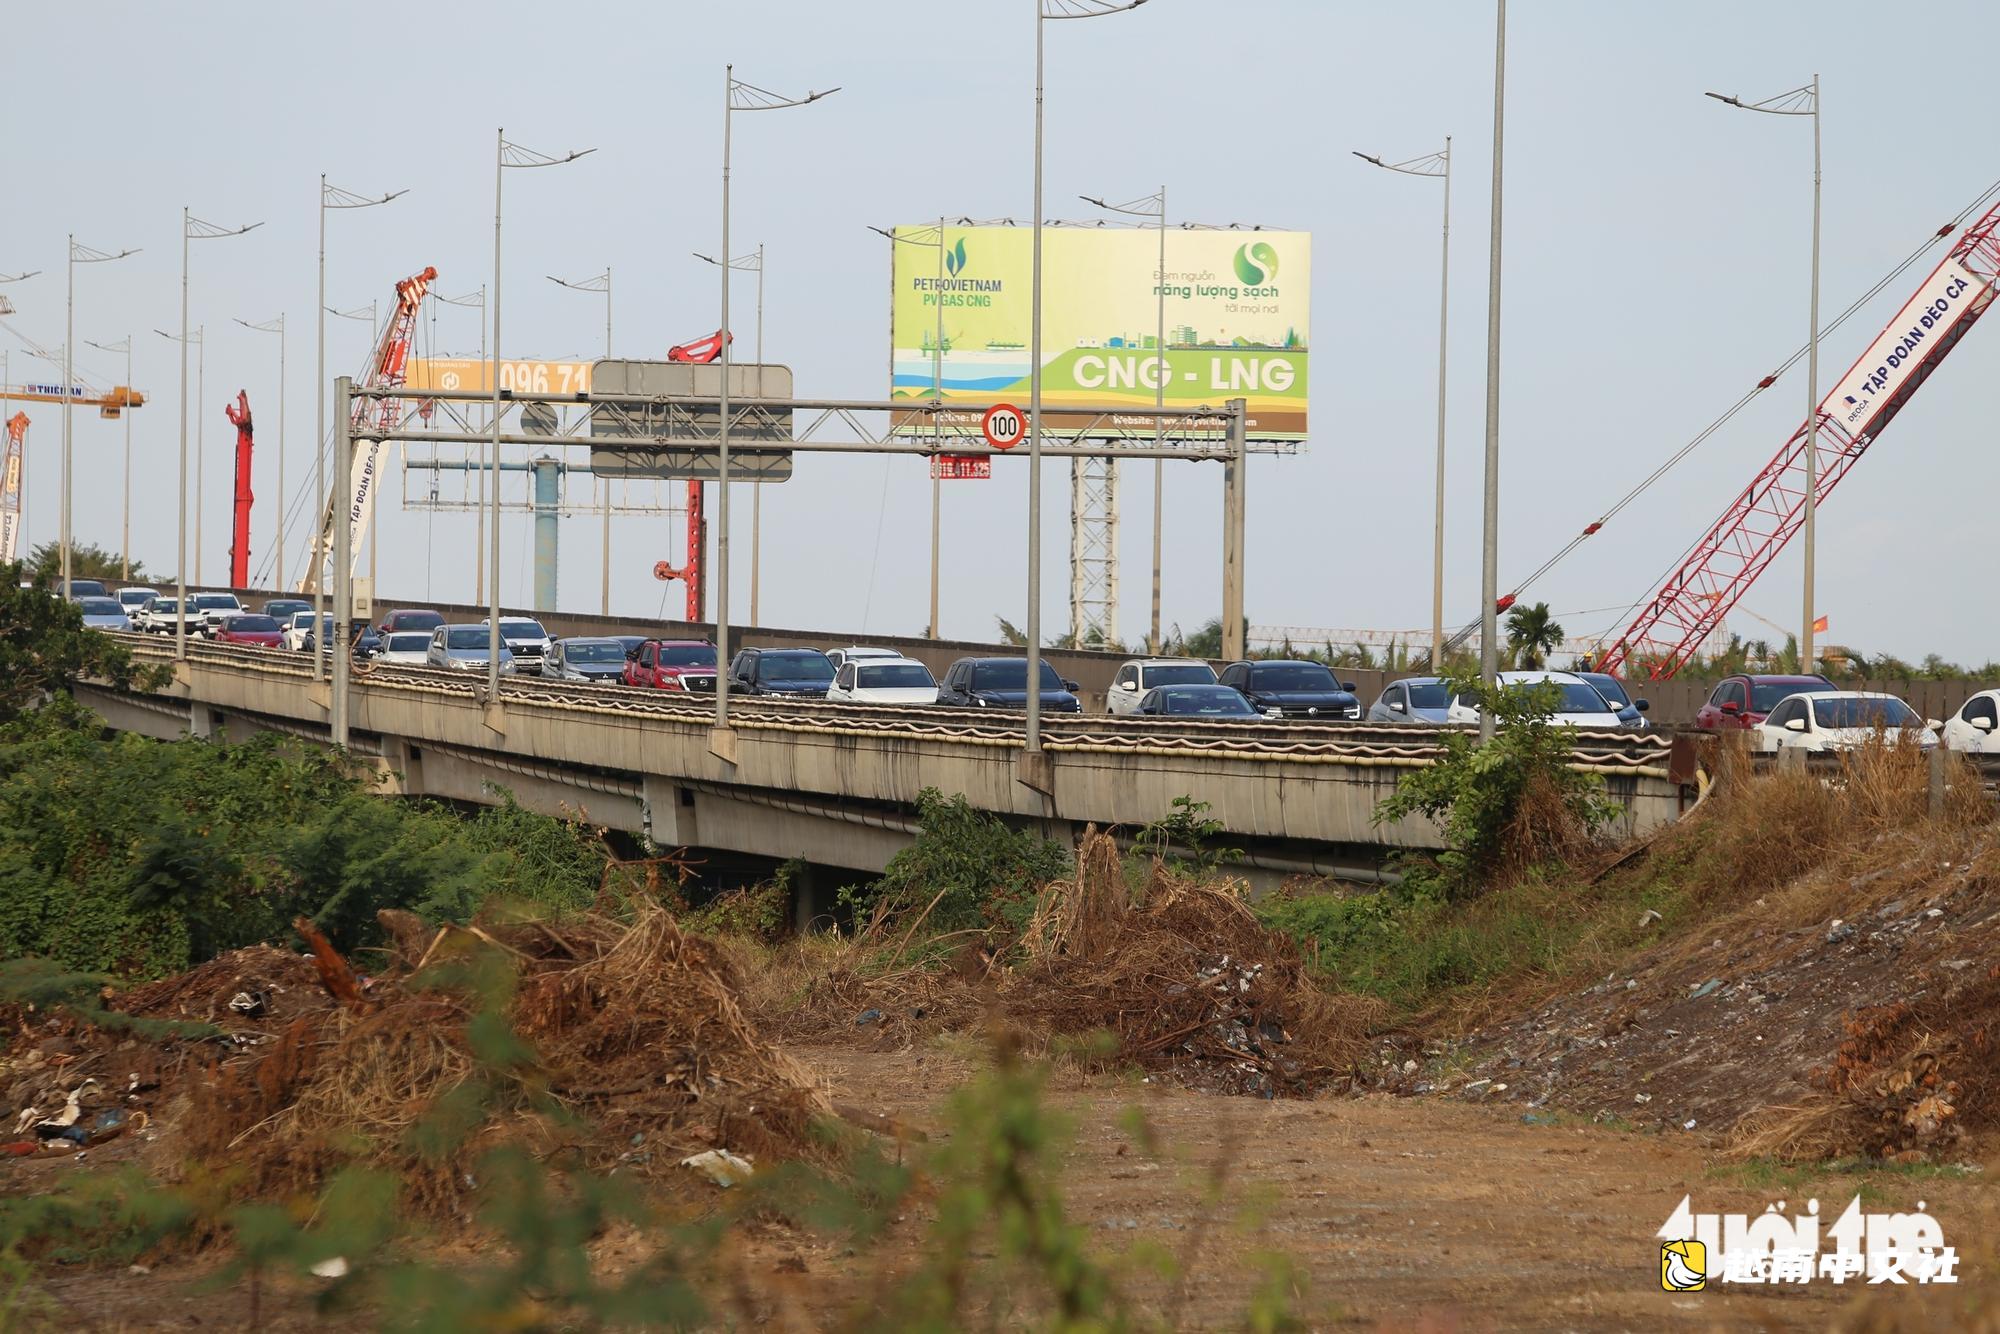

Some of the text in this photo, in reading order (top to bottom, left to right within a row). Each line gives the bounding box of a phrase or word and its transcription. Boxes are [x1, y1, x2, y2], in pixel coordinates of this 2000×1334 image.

[913, 278, 1002, 292] PETROVIETNAM
[1196, 284, 1238, 300] lượng
[1243, 285, 1279, 300] sạch
[923, 294, 991, 307] PV GAS CNG
[1862, 366, 1889, 395] TẬP
[1886, 326, 1925, 369] ĐOÀN
[1920, 298, 1949, 330] ĐÈO
[1946, 274, 1969, 299] CẢ
[1072, 355, 1173, 389] CNG
[1211, 357, 1295, 391] LNG
[1848, 400, 1869, 422] DEOCA
[992, 416, 1017, 436] 100
